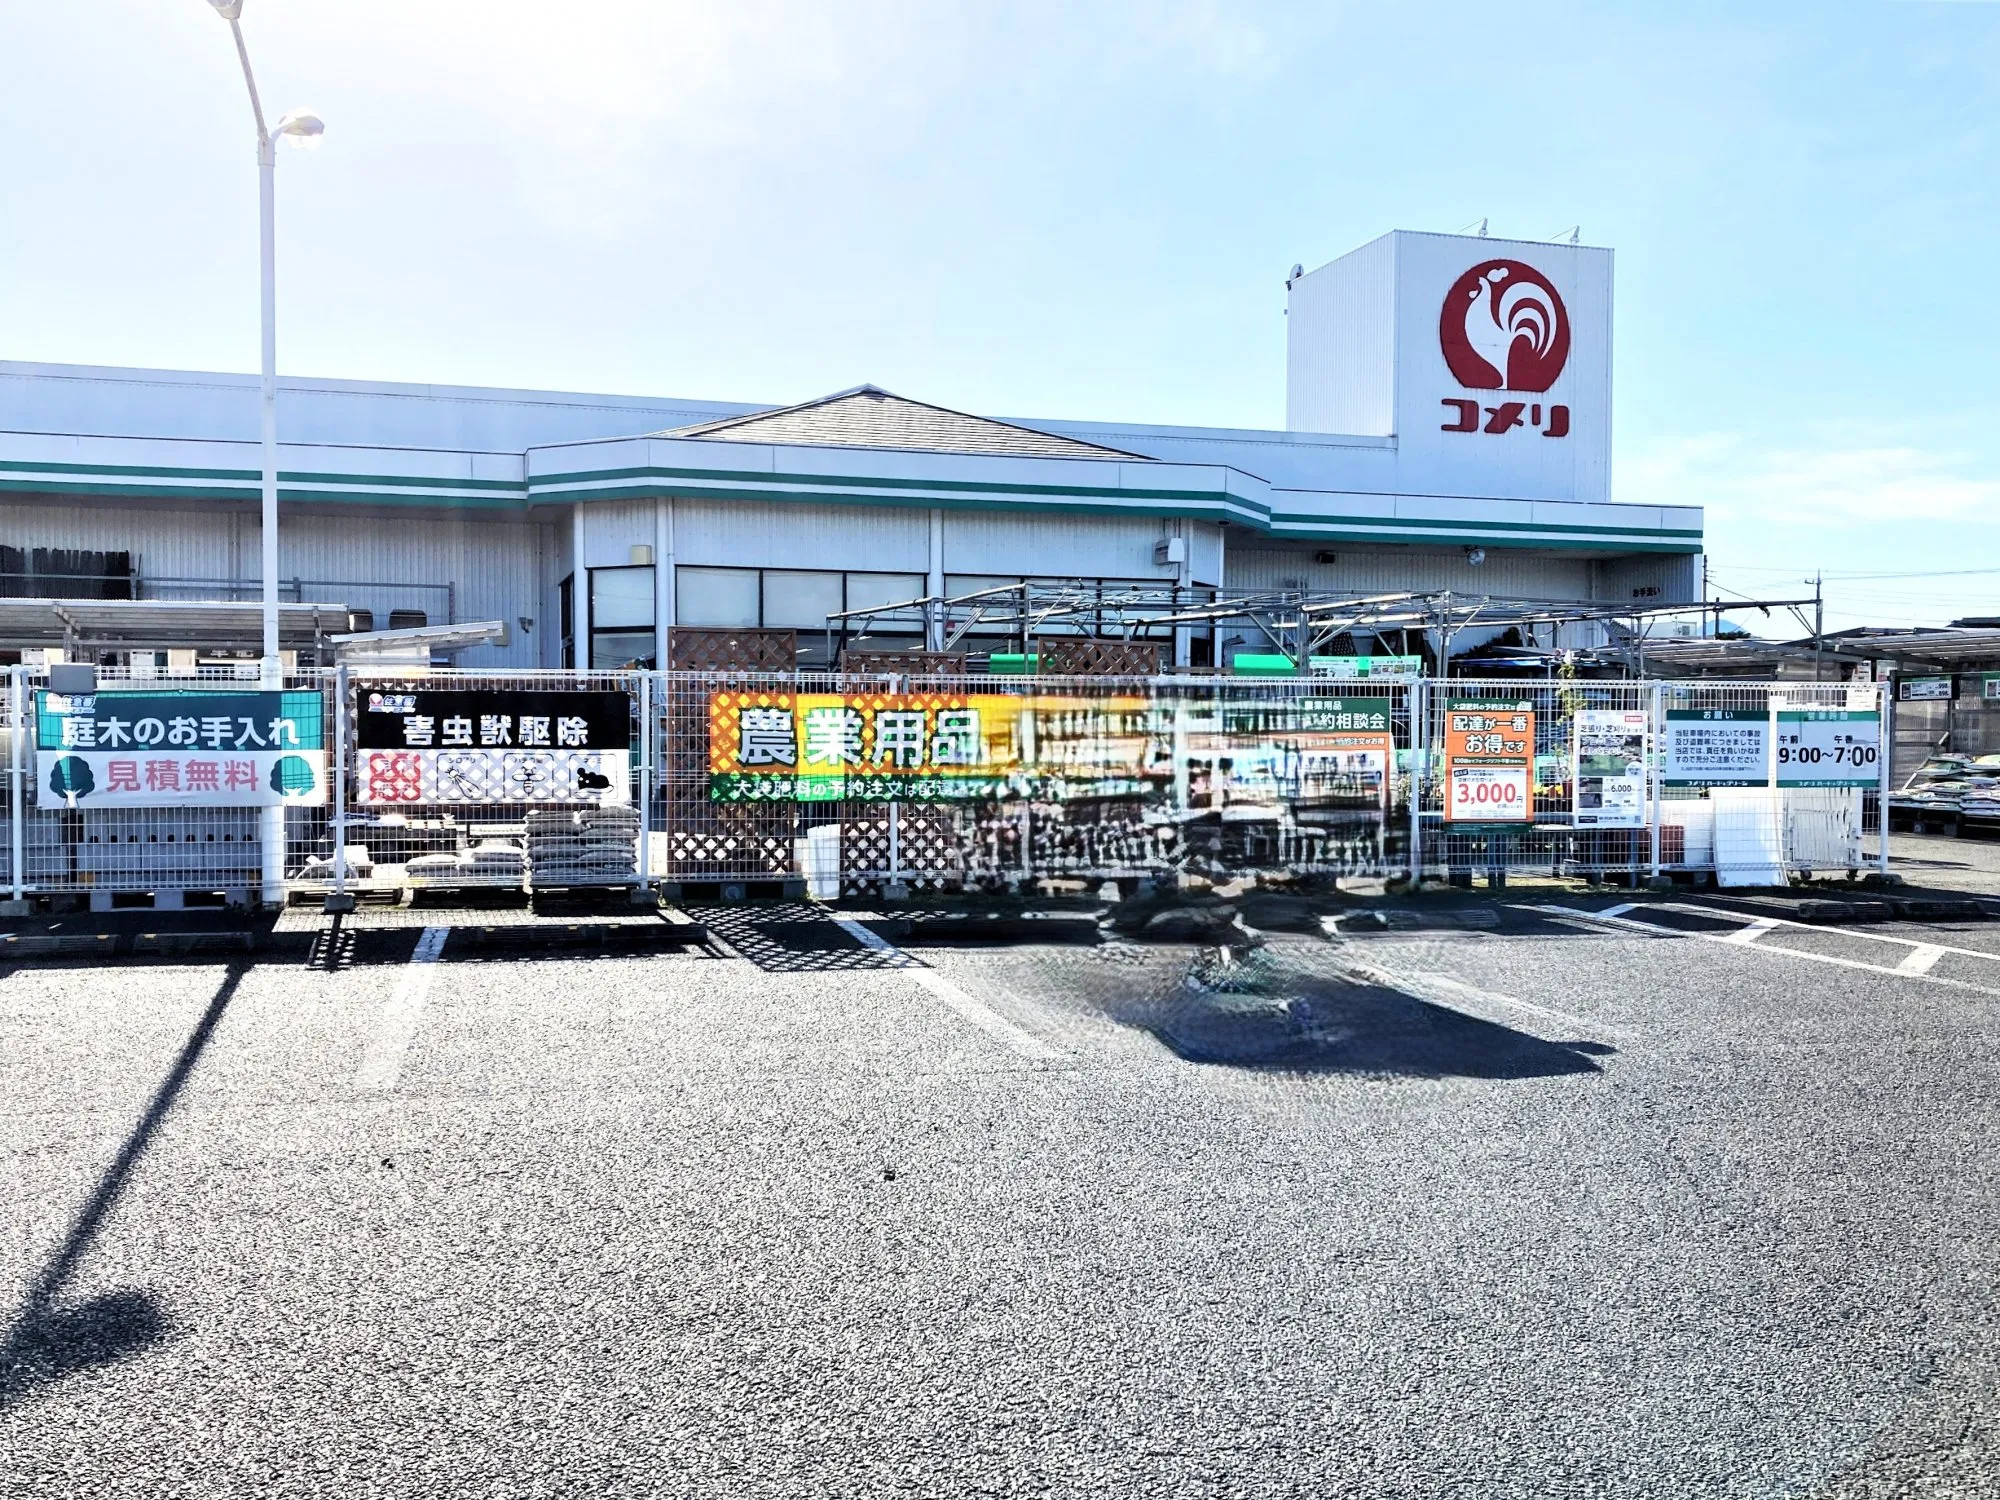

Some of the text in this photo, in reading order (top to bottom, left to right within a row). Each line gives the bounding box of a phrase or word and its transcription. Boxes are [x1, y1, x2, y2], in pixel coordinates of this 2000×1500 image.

[1441, 399, 1569, 437] コメリ
[403, 715, 589, 746] 害虫獣駆除
[1453, 715, 1527, 731] 配達が一番
[1703, 711, 1733, 719] お願い
[62, 716, 300, 747] 庭木のお手入れ
[739, 708, 979, 766] 農業用品
[1466, 734, 1527, 754] お得です
[1779, 735, 1798, 744] 午前
[106, 760, 259, 792] 見積無料
